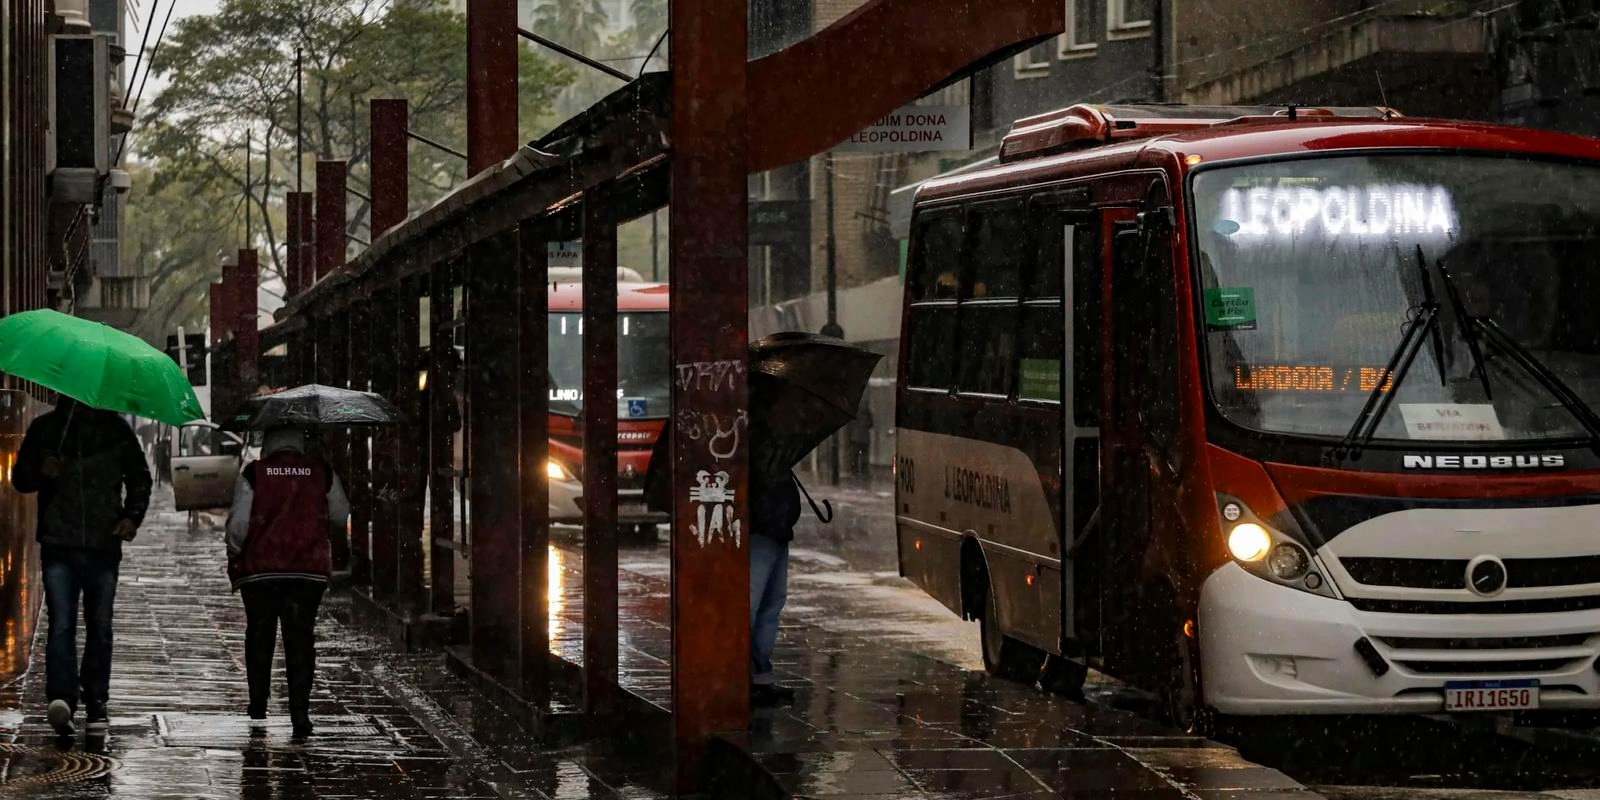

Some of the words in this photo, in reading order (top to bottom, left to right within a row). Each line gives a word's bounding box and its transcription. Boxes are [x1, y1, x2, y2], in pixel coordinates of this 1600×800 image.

[872, 114, 900, 127] DIM
[905, 115, 946, 127] DONA
[851, 130, 943, 143] LEOPOLDINA
[1229, 191, 1452, 234] LEOPOLDINA
[549, 389, 579, 401] LINIO
[1436, 408, 1463, 418] VIA
[1403, 455, 1565, 469] NEOBUS
[266, 467, 311, 476] ROLHANO
[952, 466, 1012, 515] LEOPOLDINA
[1454, 689, 1529, 708] IRI1G50
